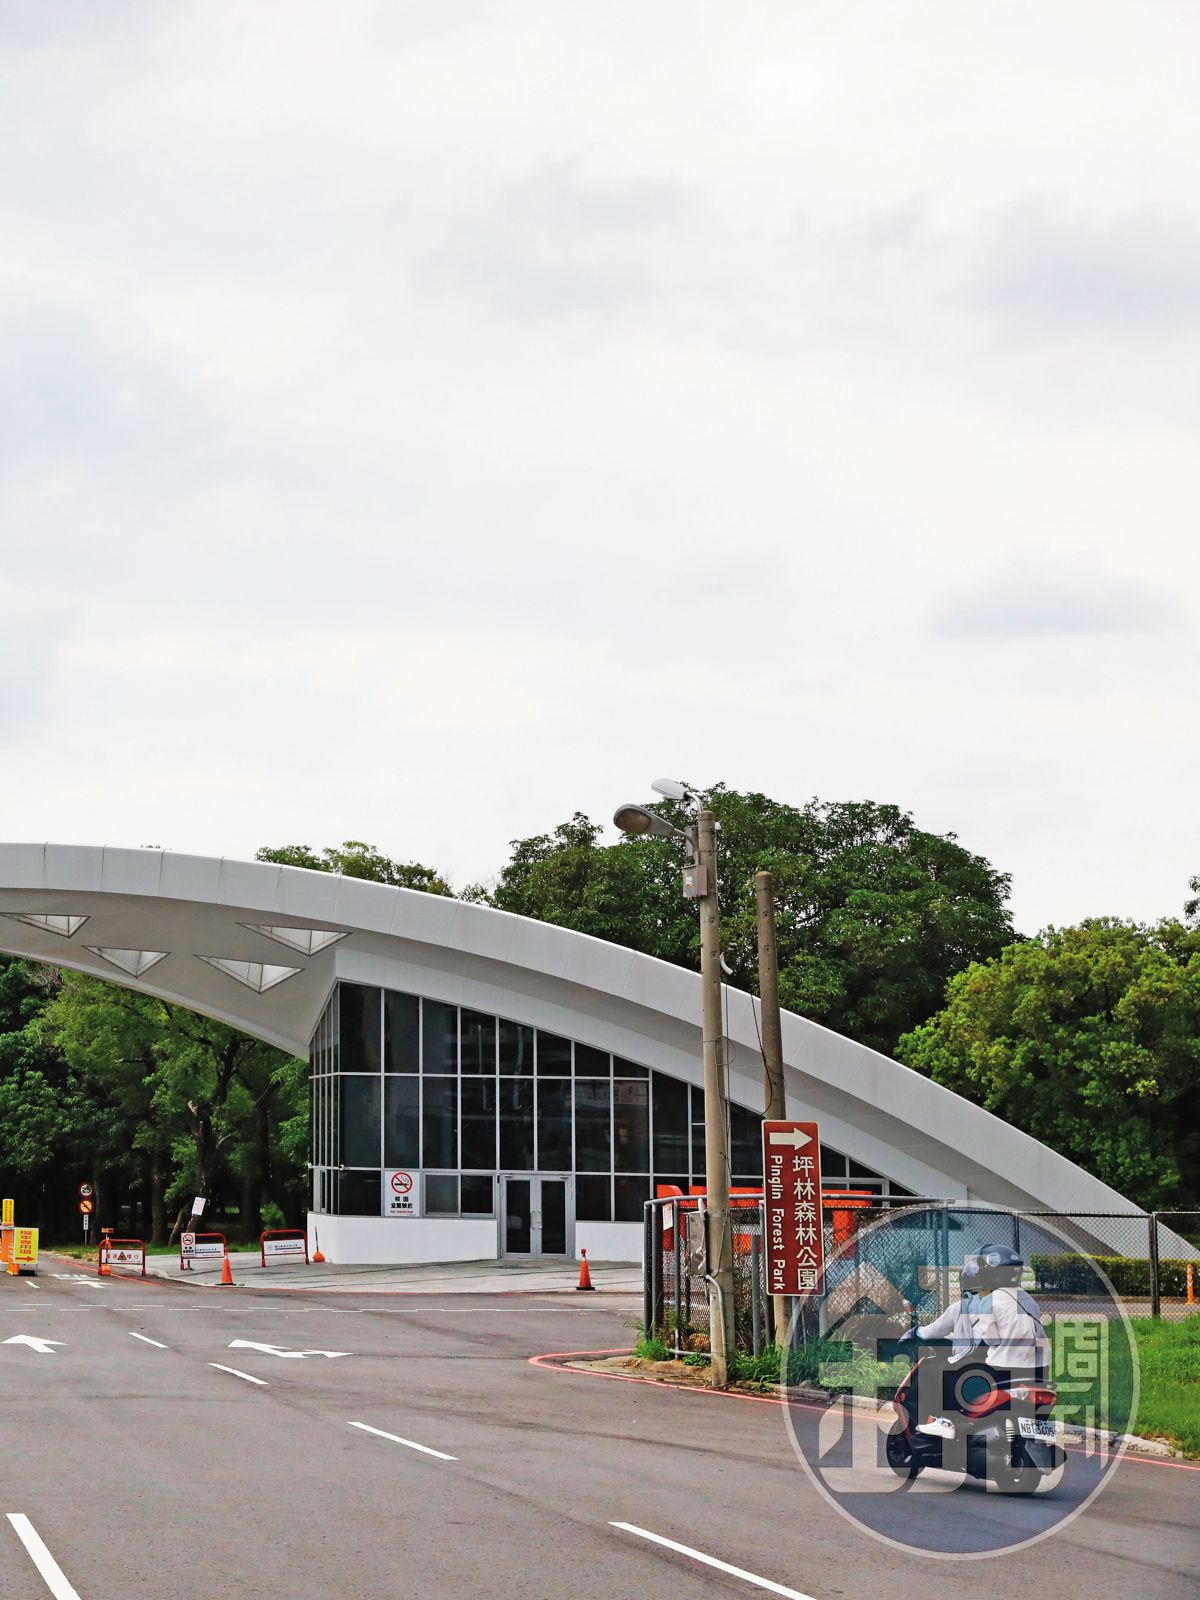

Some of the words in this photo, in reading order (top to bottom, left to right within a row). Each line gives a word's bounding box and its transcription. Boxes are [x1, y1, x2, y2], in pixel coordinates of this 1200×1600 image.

[767, 1155, 783, 1200] Pinglin
[771, 1208, 785, 1250] Forest
[792, 1155, 818, 1291] 坪林森林公園
[773, 1259, 786, 1290] Park
